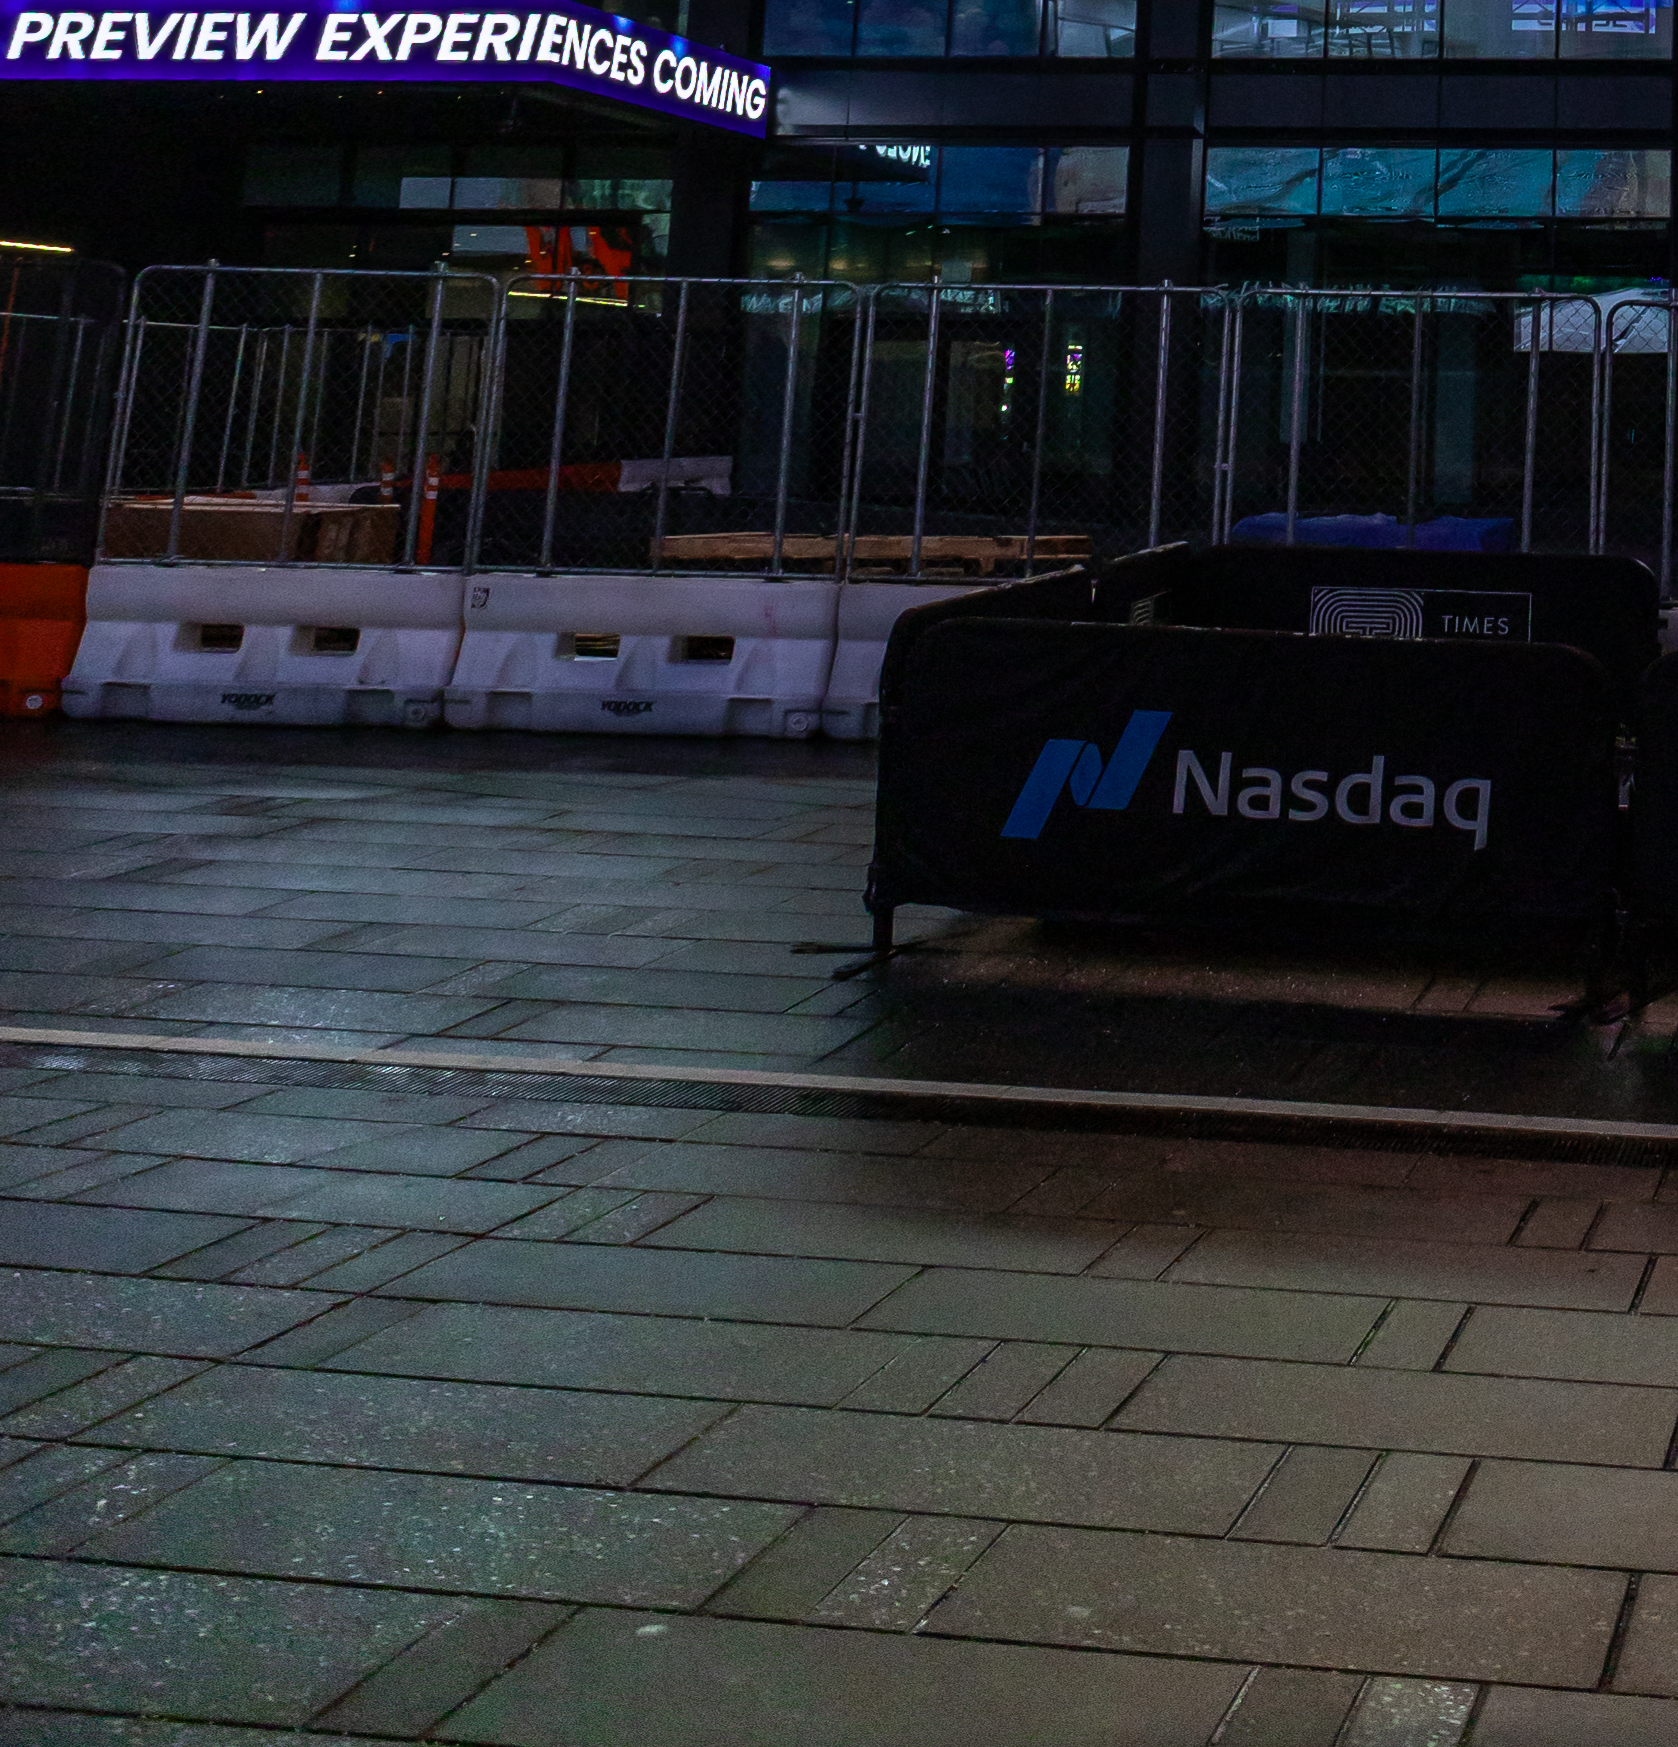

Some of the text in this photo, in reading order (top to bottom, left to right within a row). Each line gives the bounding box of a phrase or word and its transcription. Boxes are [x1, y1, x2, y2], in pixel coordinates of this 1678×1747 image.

[6, 12, 767, 120] PREVIEW EXPERIENCES COMING
[1441, 614, 1511, 636] TIMES
[1171, 749, 1493, 851] Nasdaq
